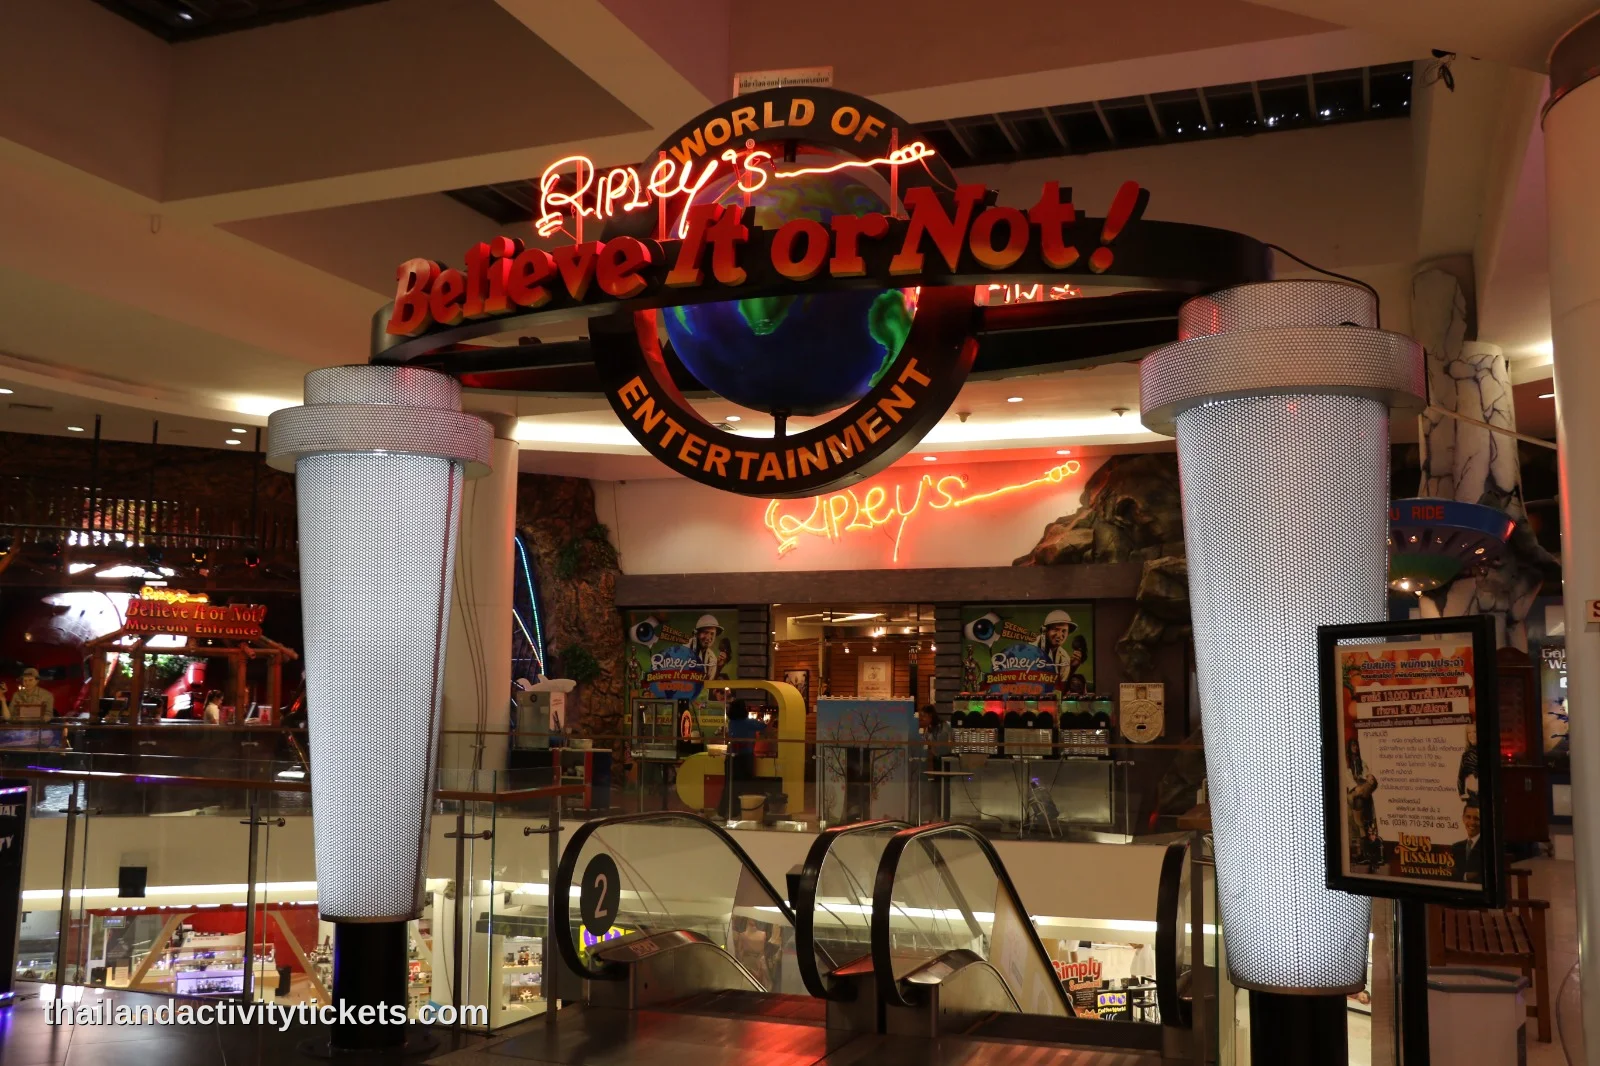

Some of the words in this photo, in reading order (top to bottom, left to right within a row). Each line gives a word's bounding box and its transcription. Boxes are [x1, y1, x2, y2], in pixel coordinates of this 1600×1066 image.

[669, 98, 816, 164] WORLD
[831, 106, 886, 143] OF
[386, 236, 650, 336] Believe
[665, 203, 748, 287] It
[771, 213, 889, 281] or
[889, 180, 1140, 276] Not!
[617, 357, 932, 482] ENTERTAINMENT
[1411, 505, 1445, 520] RIDE
[126, 602, 189, 618] Believe
[192, 604, 208, 620] It
[209, 608, 226, 621] or
[125, 620, 188, 632] Museum
[195, 625, 259, 636] Entrance
[647, 672, 672, 681] Believe
[986, 673, 1016, 683] Believe
[594, 873, 608, 919] 2
